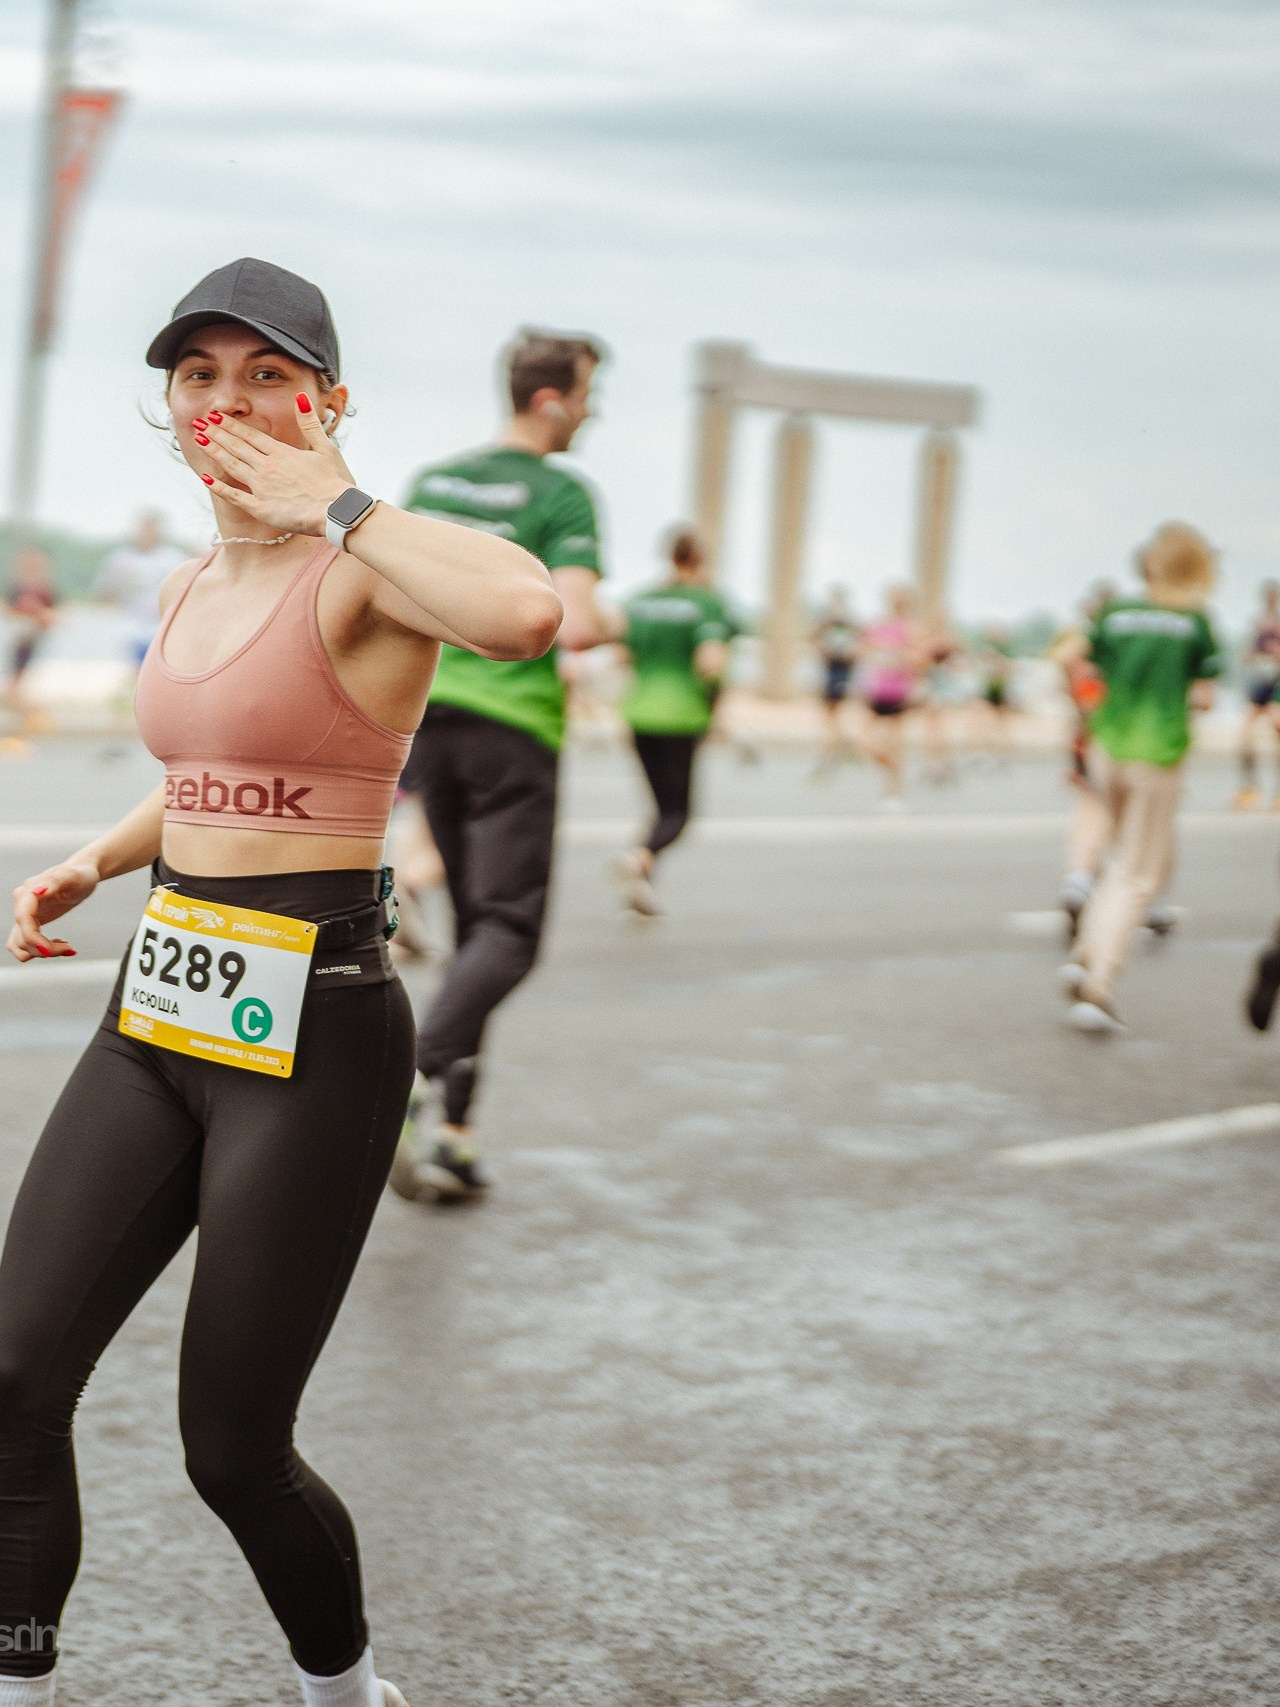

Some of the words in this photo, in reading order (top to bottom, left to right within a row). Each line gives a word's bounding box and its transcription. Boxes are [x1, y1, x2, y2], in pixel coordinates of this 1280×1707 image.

[165, 771, 314, 820] eebok
[139, 926, 247, 999] 5289
[131, 987, 181, 1017] КСЮША
